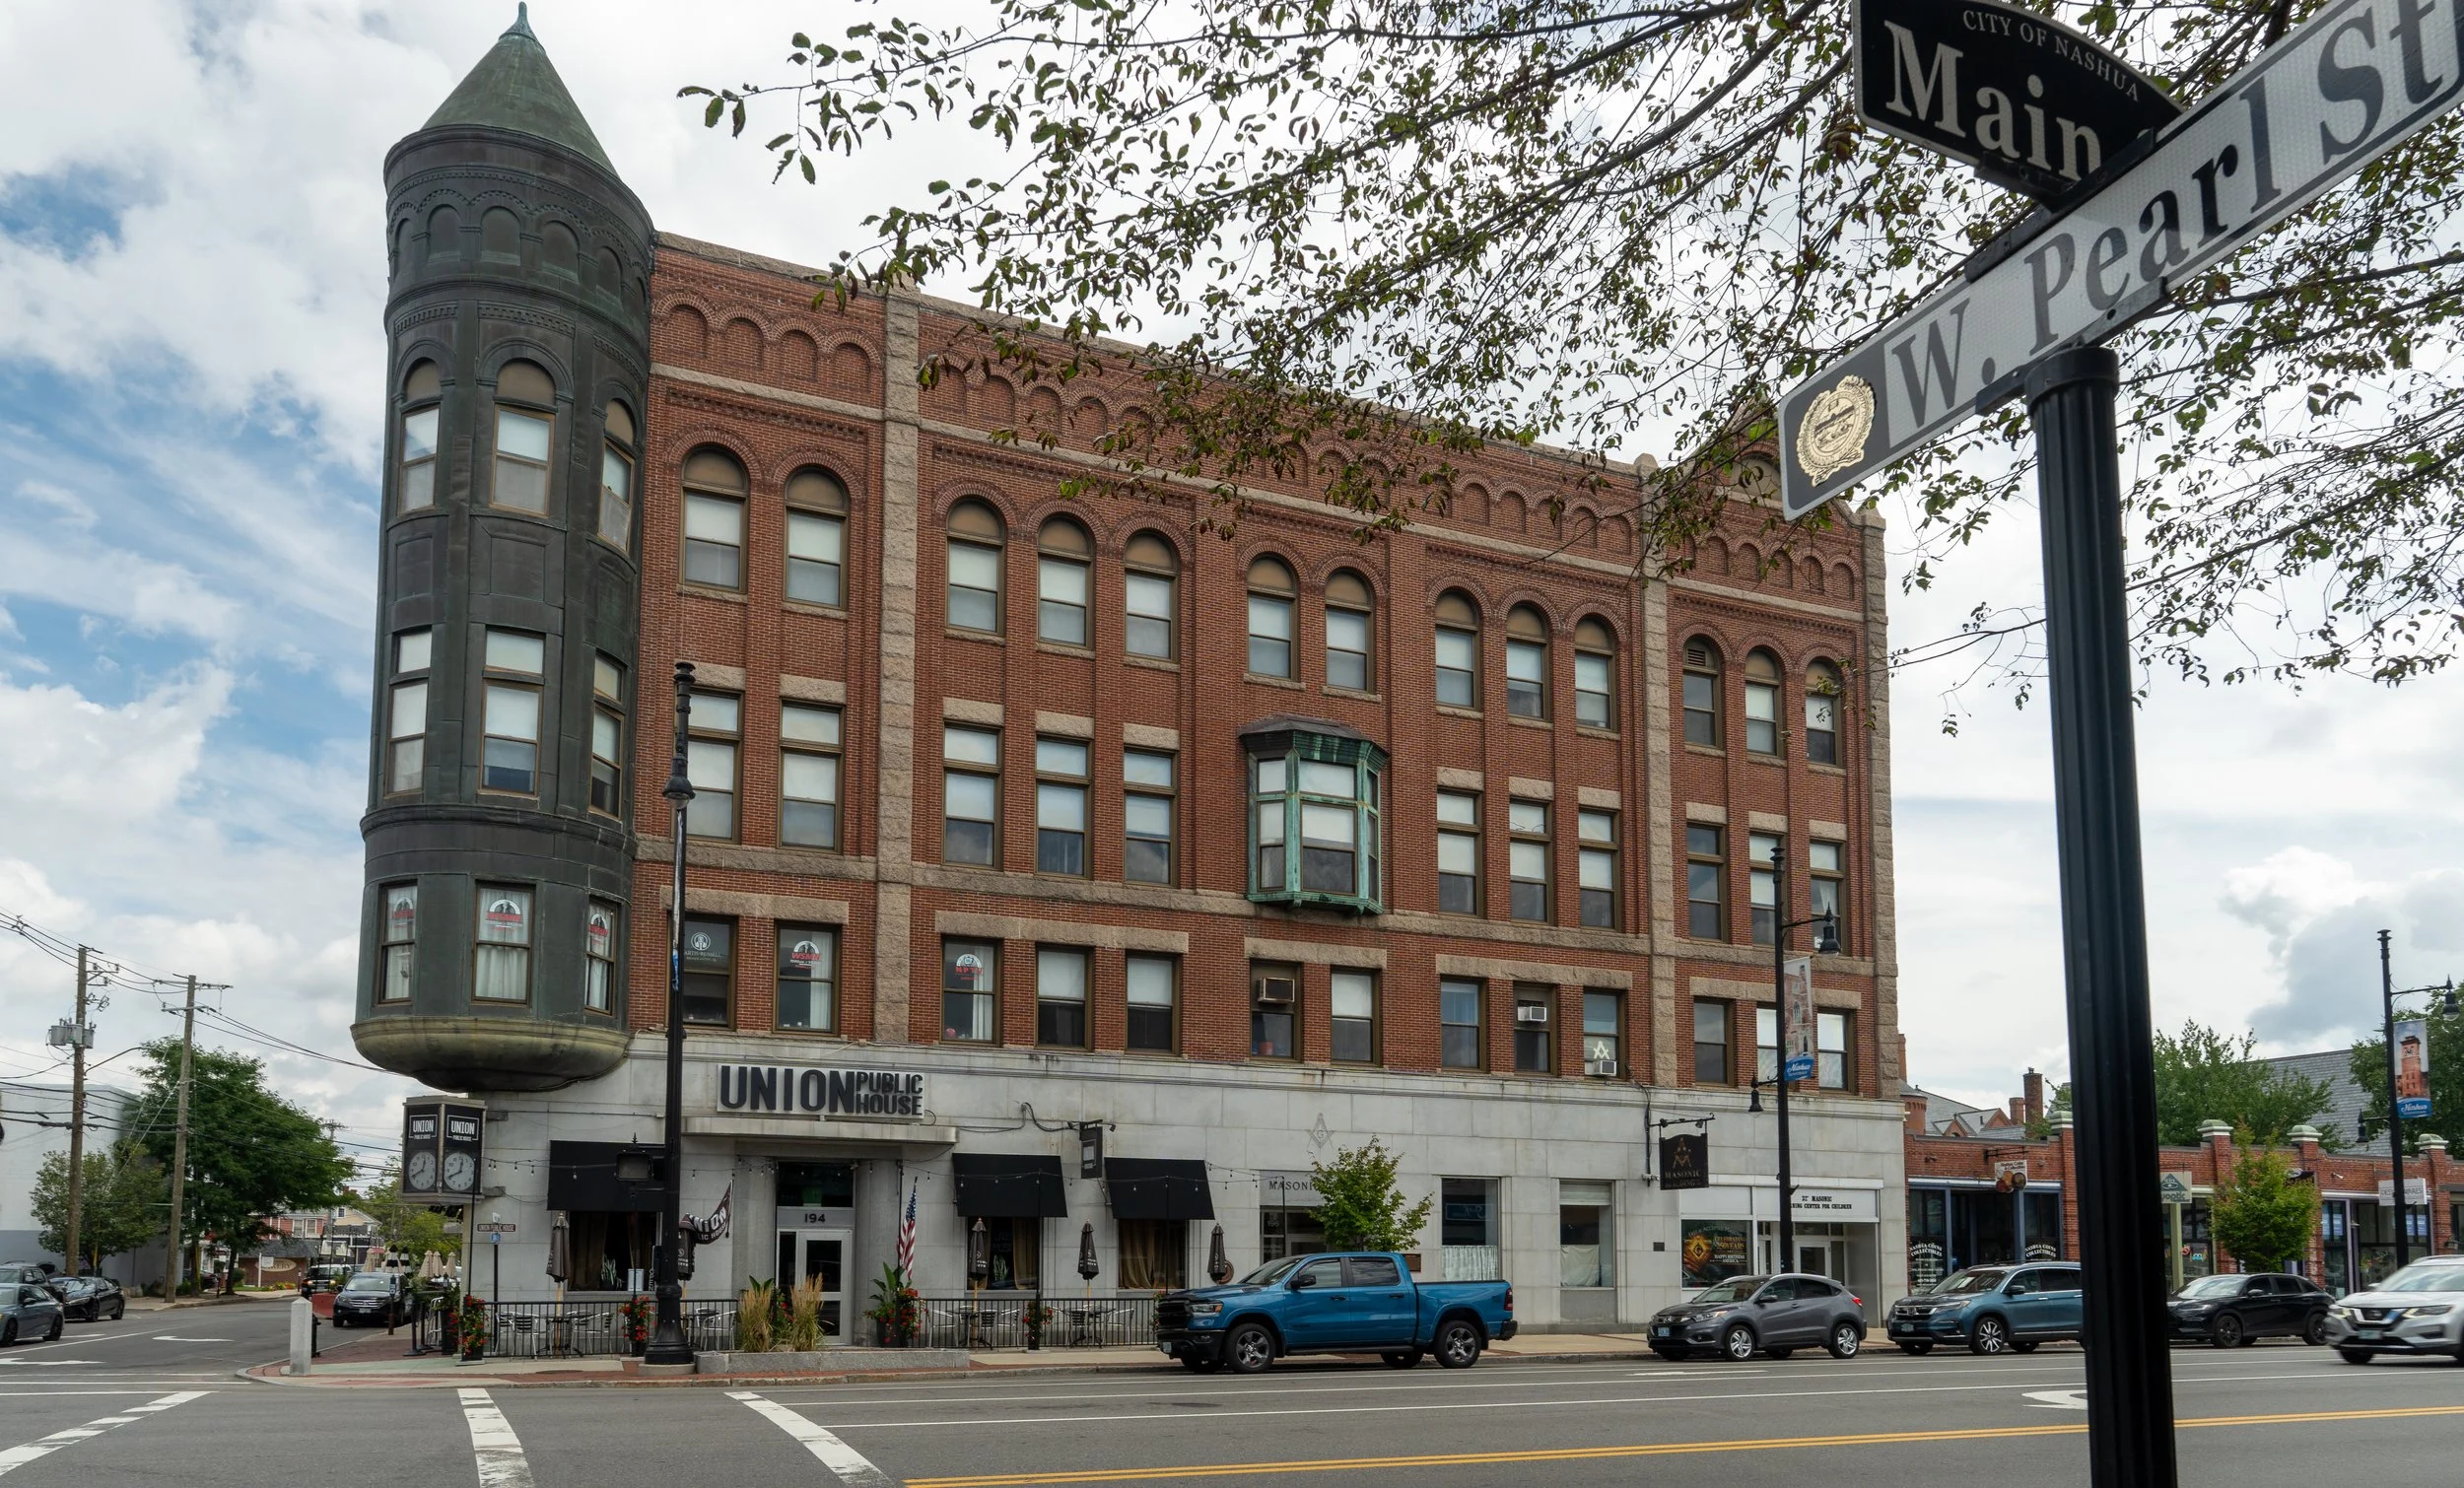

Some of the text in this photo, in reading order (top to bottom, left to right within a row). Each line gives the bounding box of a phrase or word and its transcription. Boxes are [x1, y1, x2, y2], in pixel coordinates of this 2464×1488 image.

[1963, 10, 2139, 102] CITY OF NASHUA
[1883, 20, 2101, 182] Main
[1891, 0, 2443, 429] W. Pearl St
[720, 1065, 855, 1114] UNION
[856, 1071, 924, 1094] PUBLIC
[856, 1093, 924, 1116] HOUSE
[413, 1119, 434, 1132] UNION
[450, 1120, 475, 1134] UNION
[1268, 1181, 1313, 1191] MASONI
[804, 1213, 826, 1223] 194
[1910, 1248, 1943, 1257] COLLECTIBLES
[2025, 1249, 2057, 1258] COLLECTIBLES
[2042, 1244, 2057, 1252] COINS
